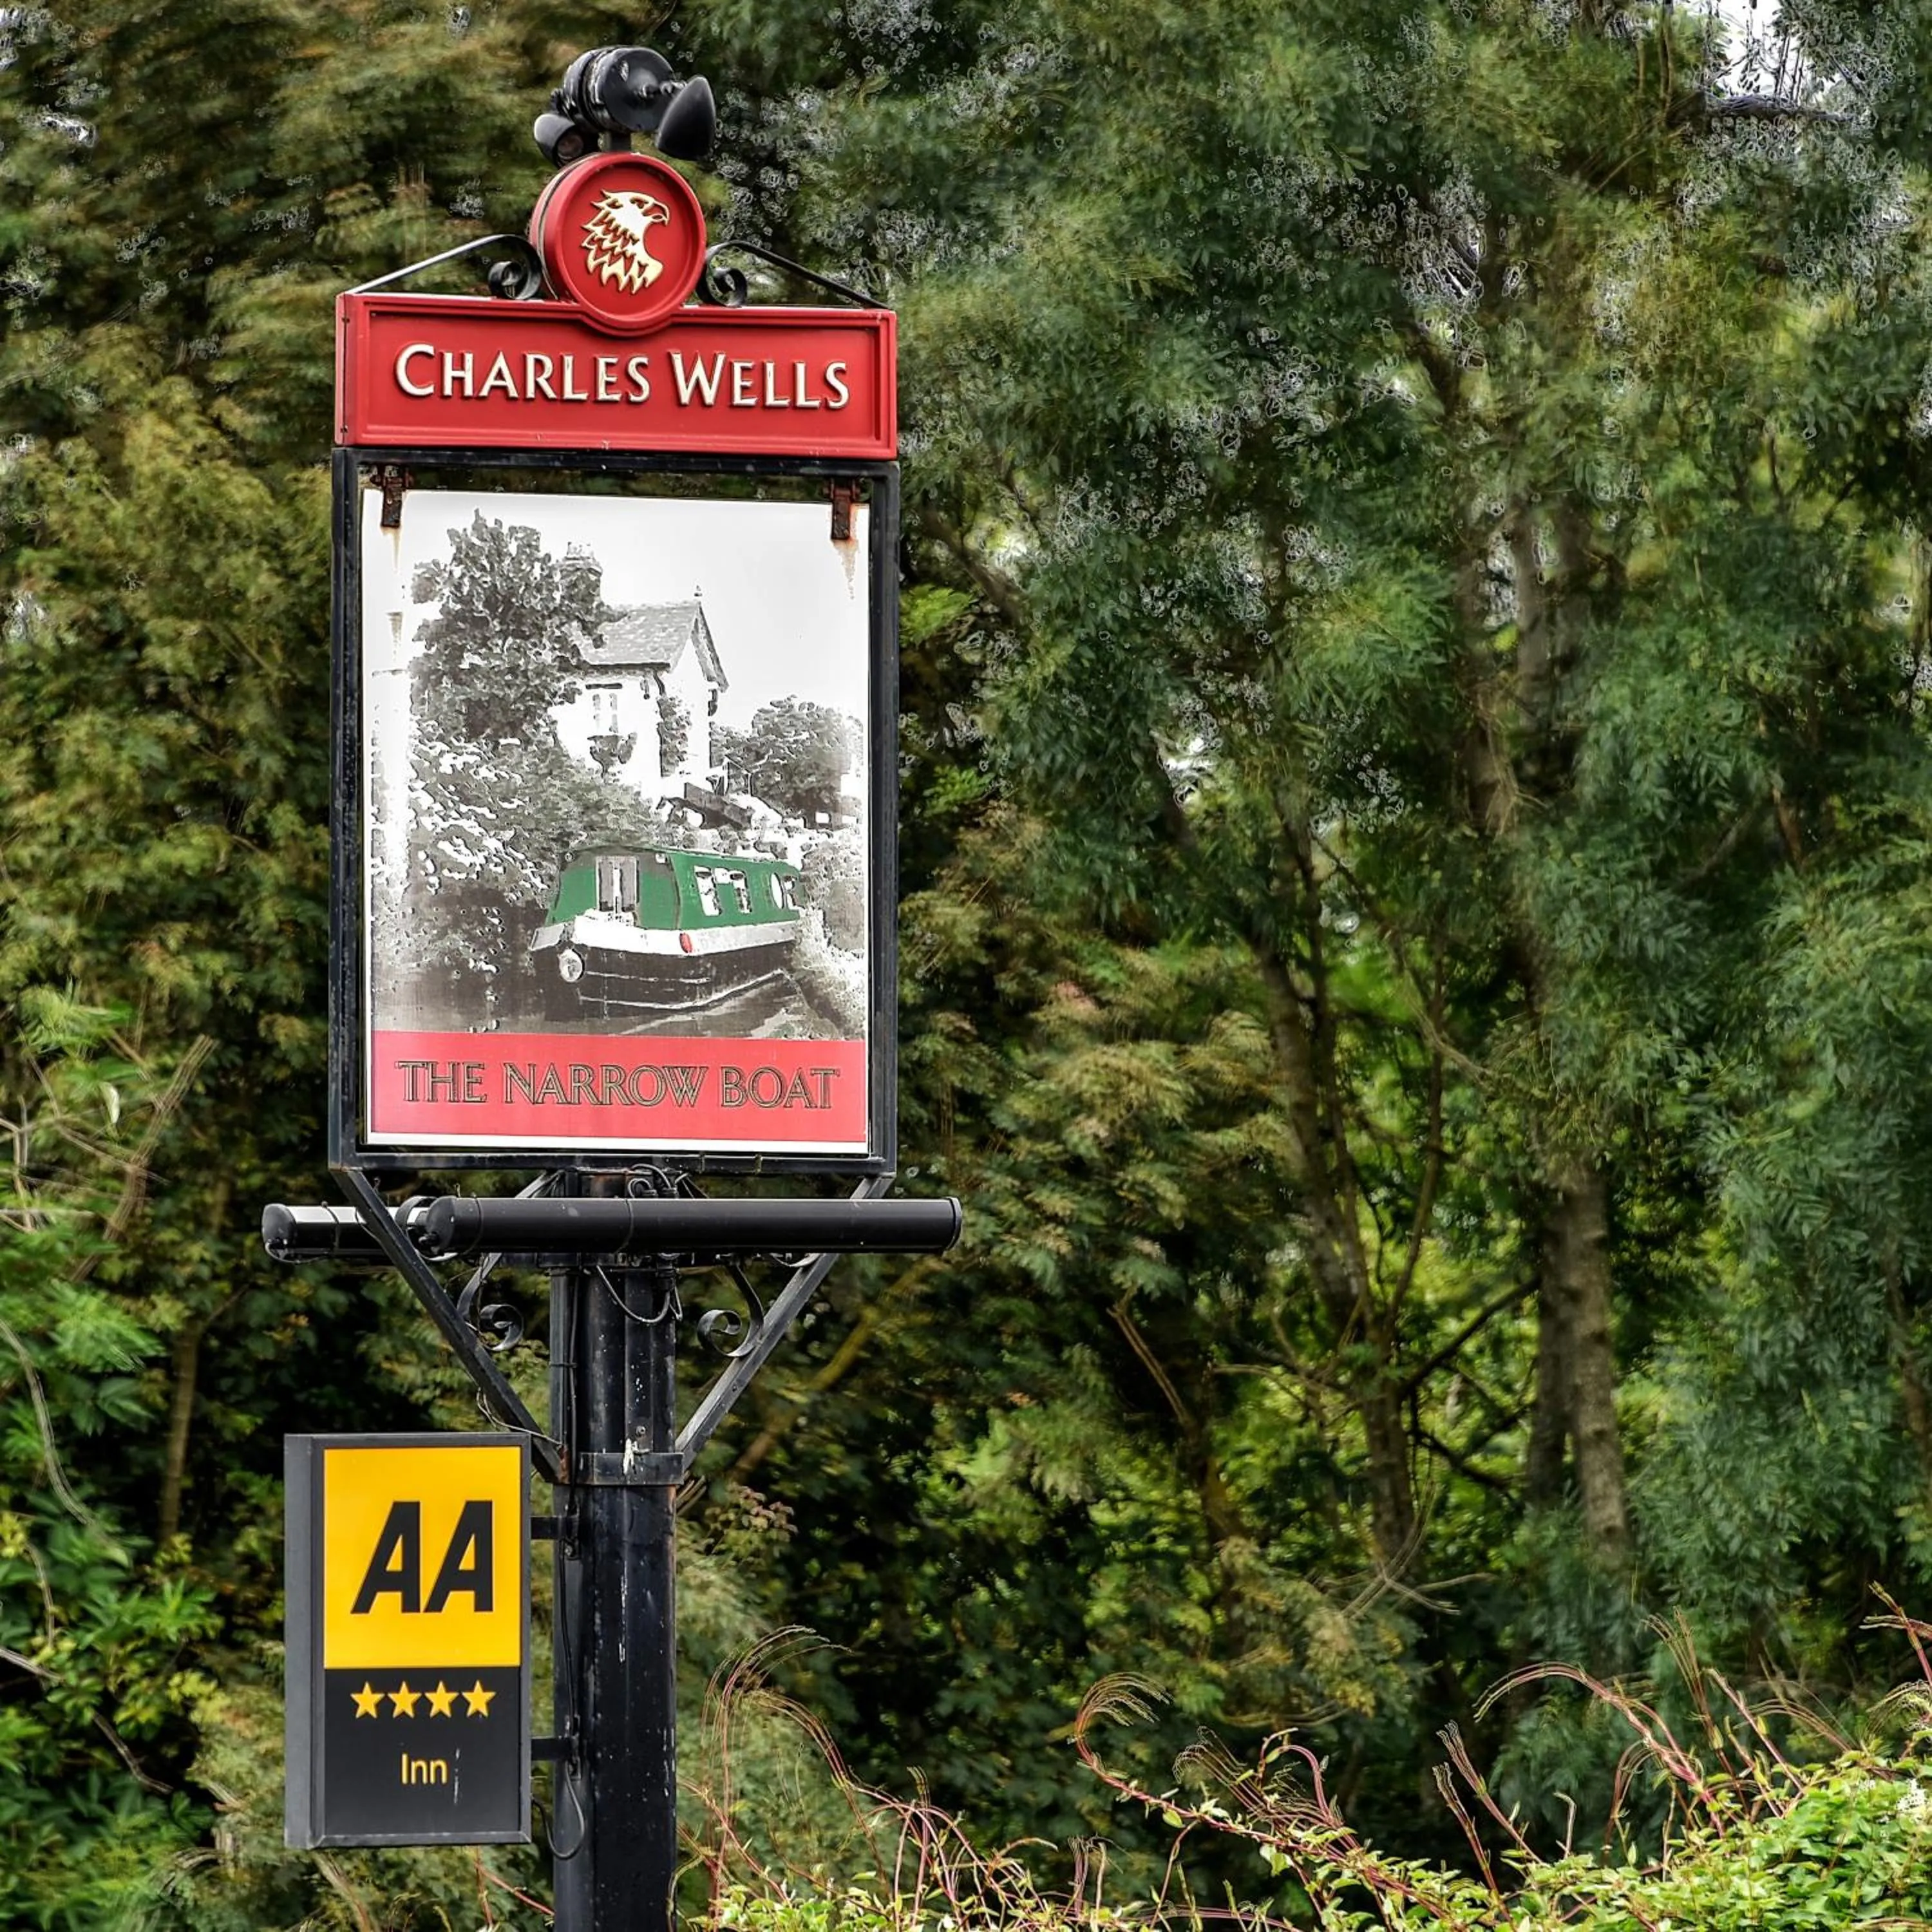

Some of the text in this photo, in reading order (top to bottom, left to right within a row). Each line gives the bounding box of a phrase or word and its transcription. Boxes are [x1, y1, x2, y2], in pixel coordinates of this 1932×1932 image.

[395, 343, 850, 410] CHARLES WELLS
[395, 1060, 840, 1109] THE NARROW BOAT
[350, 1499, 494, 1615] AA
[401, 1753, 448, 1784] Inn
